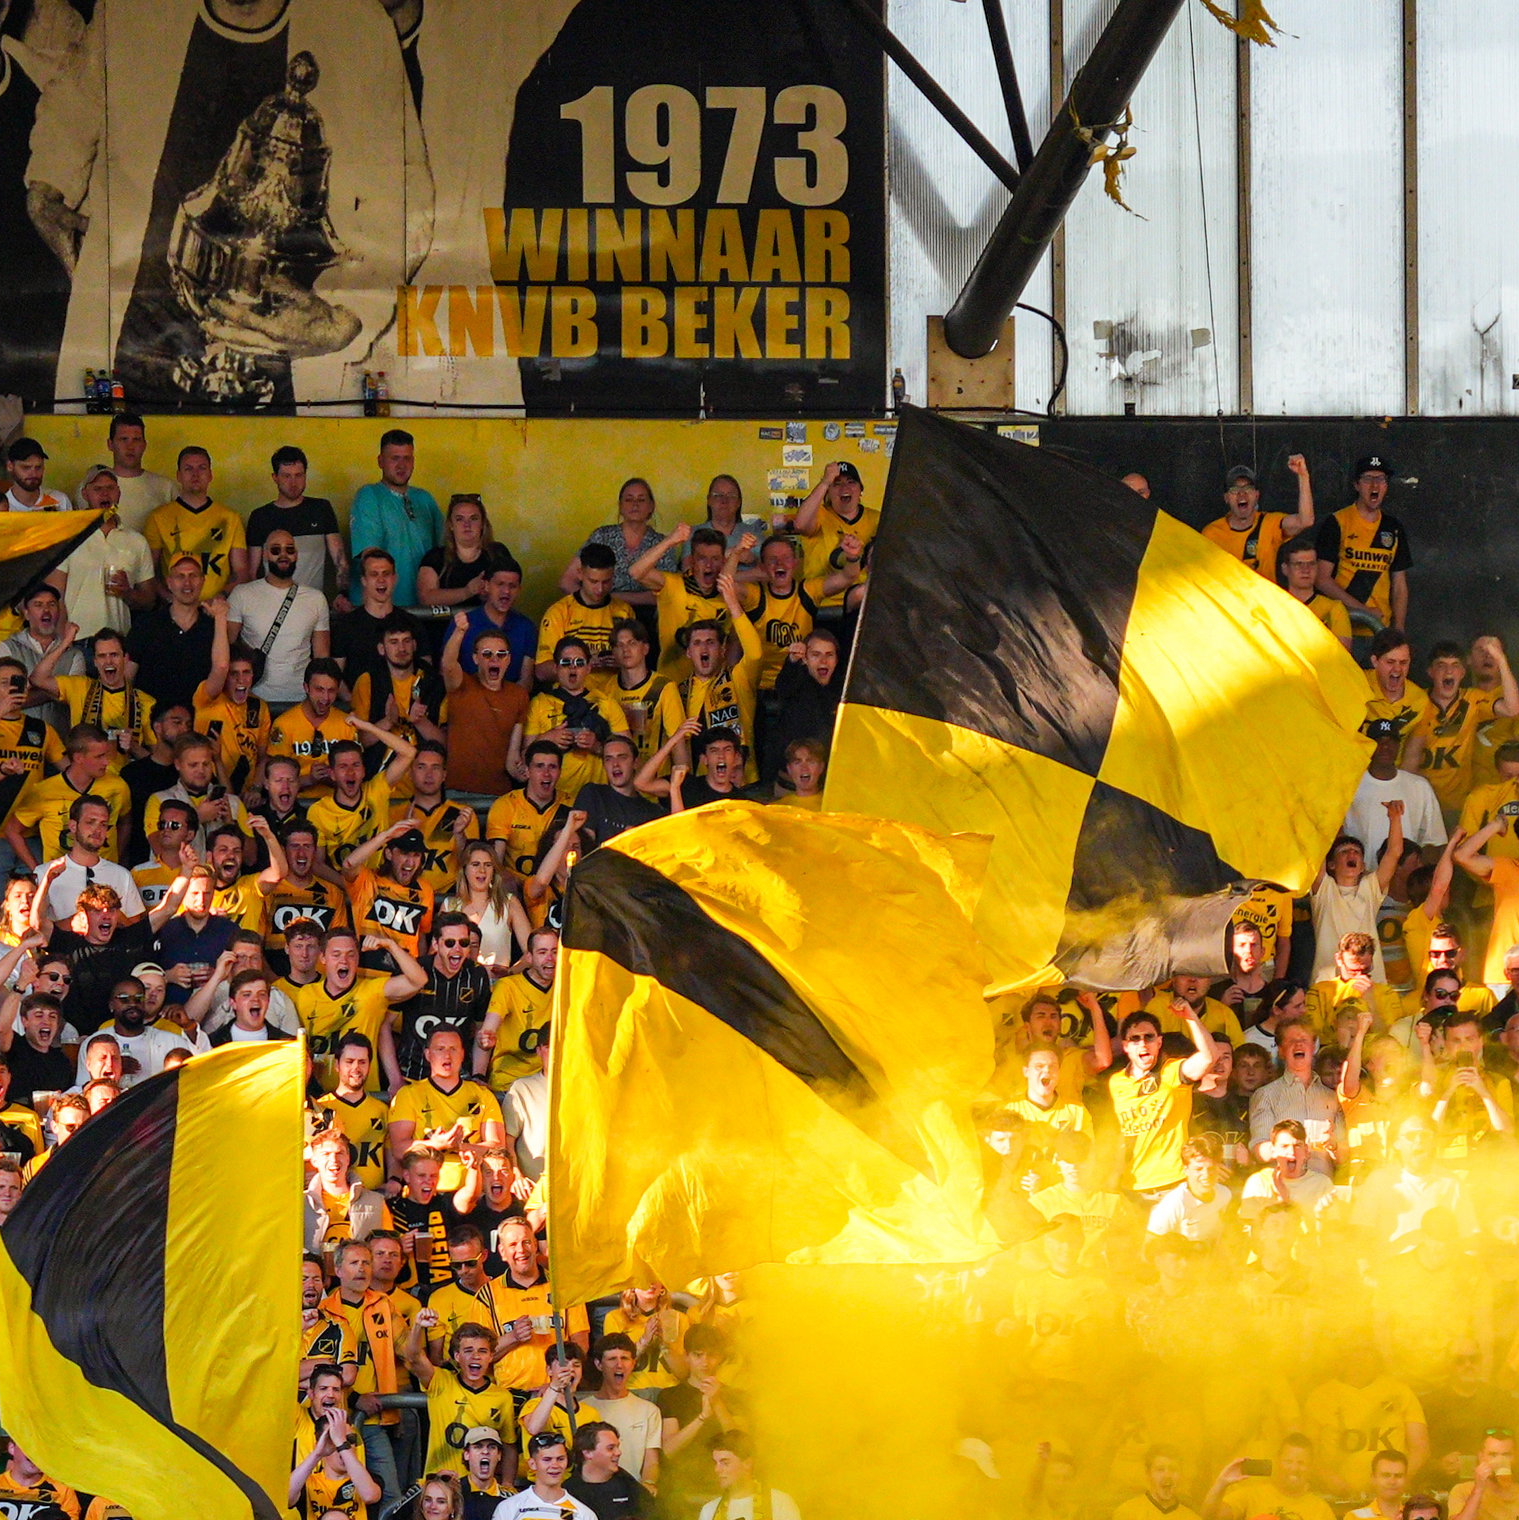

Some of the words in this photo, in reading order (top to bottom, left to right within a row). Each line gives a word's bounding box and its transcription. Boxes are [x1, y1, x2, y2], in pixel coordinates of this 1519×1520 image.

[560, 83, 849, 206] 1973
[483, 208, 851, 282] WINNAAR
[396, 286, 598, 358] KNVB
[621, 286, 851, 359] BEKER
[711, 708, 739, 723] NAC
[275, 906, 328, 934] OK
[372, 899, 426, 934] OK
